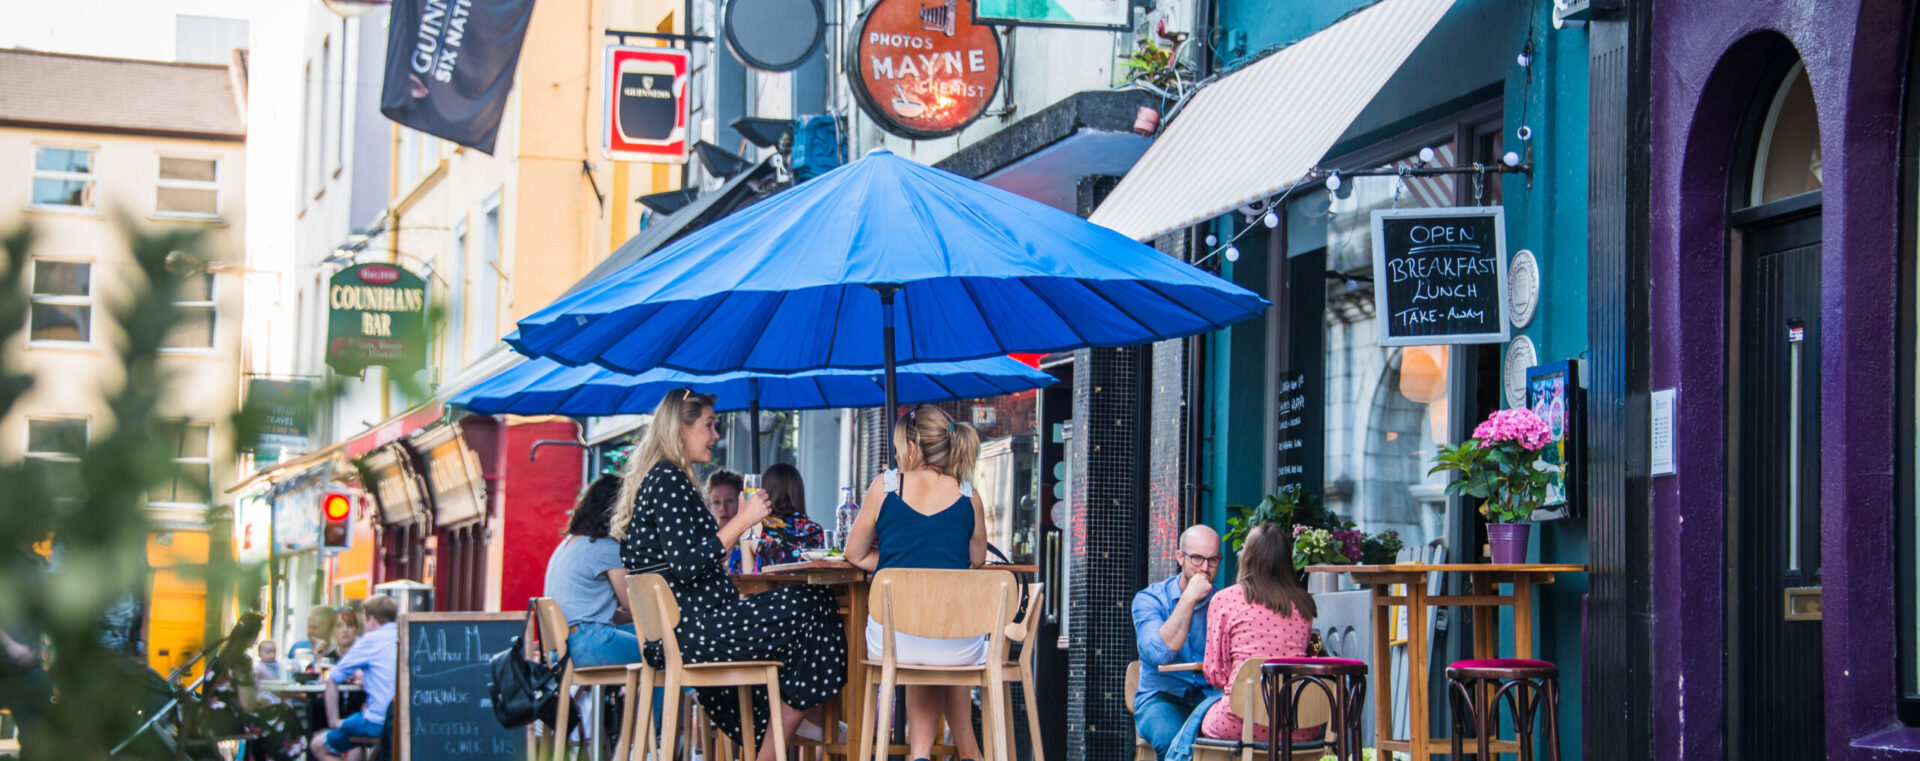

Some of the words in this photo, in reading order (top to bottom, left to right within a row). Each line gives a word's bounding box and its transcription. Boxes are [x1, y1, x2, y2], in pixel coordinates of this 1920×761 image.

[869, 32, 933, 50] PHOTOS
[435, 48, 458, 83] SIX
[872, 49, 985, 80] MAYNE
[623, 87, 671, 99] GUINNESS
[920, 80, 985, 98] CHEMIST
[1410, 225, 1474, 244] OPEN
[1388, 256, 1496, 283] BREAKFAST
[330, 284, 424, 312] COUNIHANS
[1412, 279, 1478, 303] LUNCH
[361, 312, 392, 337] BAR
[413, 625, 463, 663] Arthur
